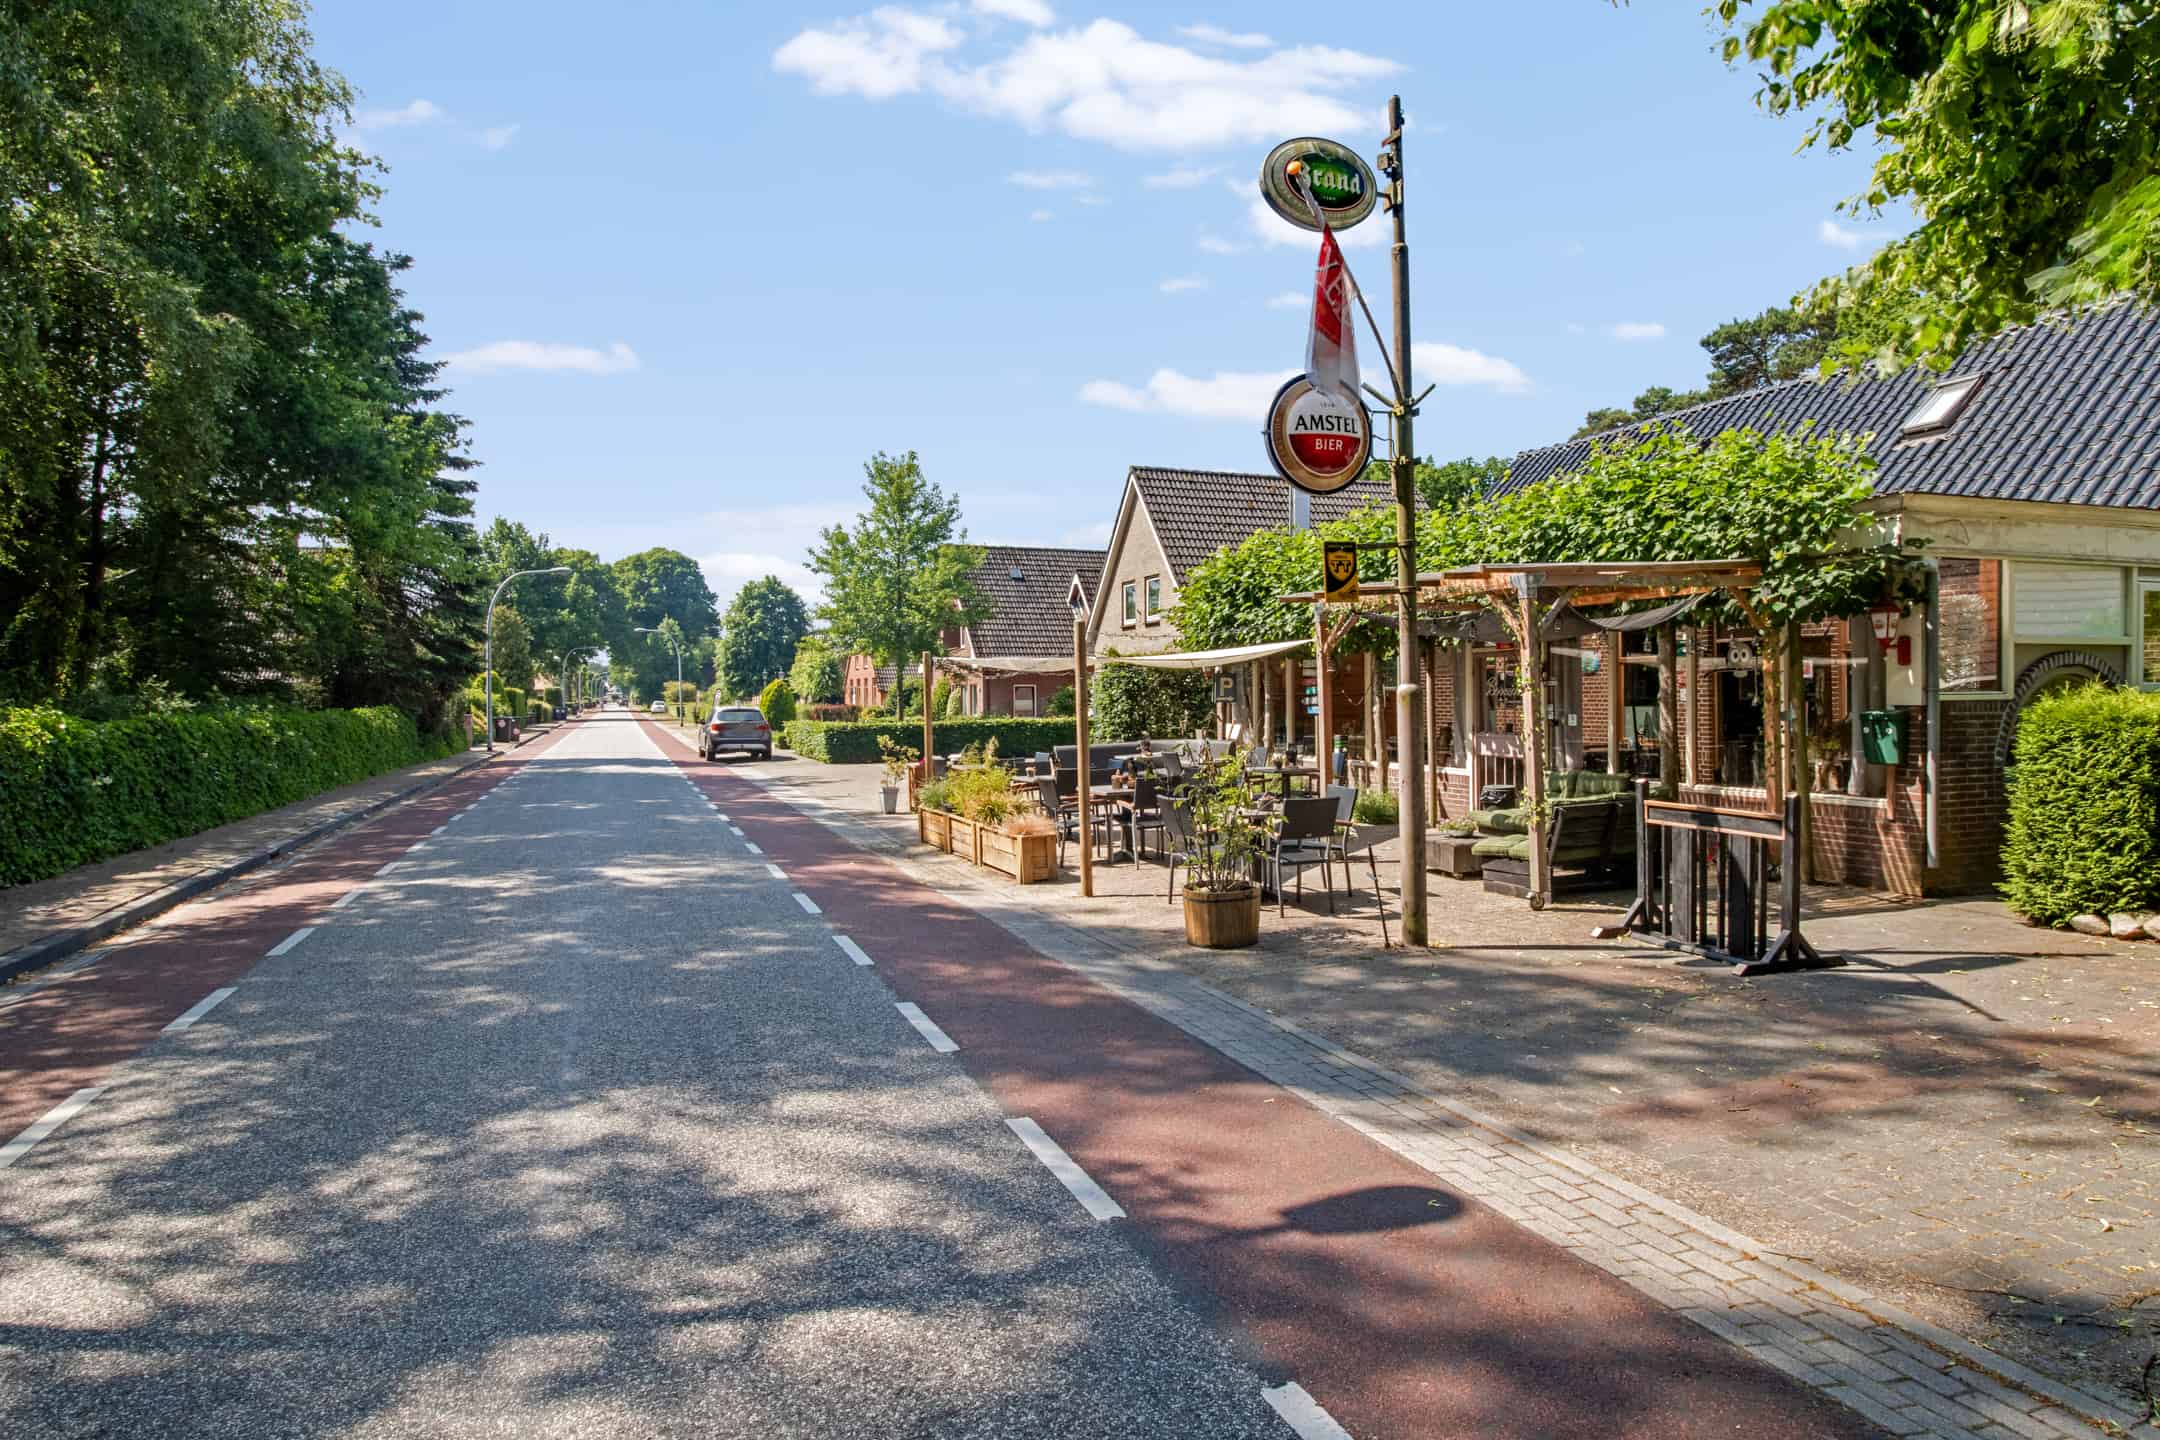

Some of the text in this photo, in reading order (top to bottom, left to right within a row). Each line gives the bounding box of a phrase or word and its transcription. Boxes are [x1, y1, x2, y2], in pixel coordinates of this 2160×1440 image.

[1295, 414, 1359, 433] AMSTEL
[1315, 438, 1343, 451] BIER
[1220, 677, 1233, 697] P
